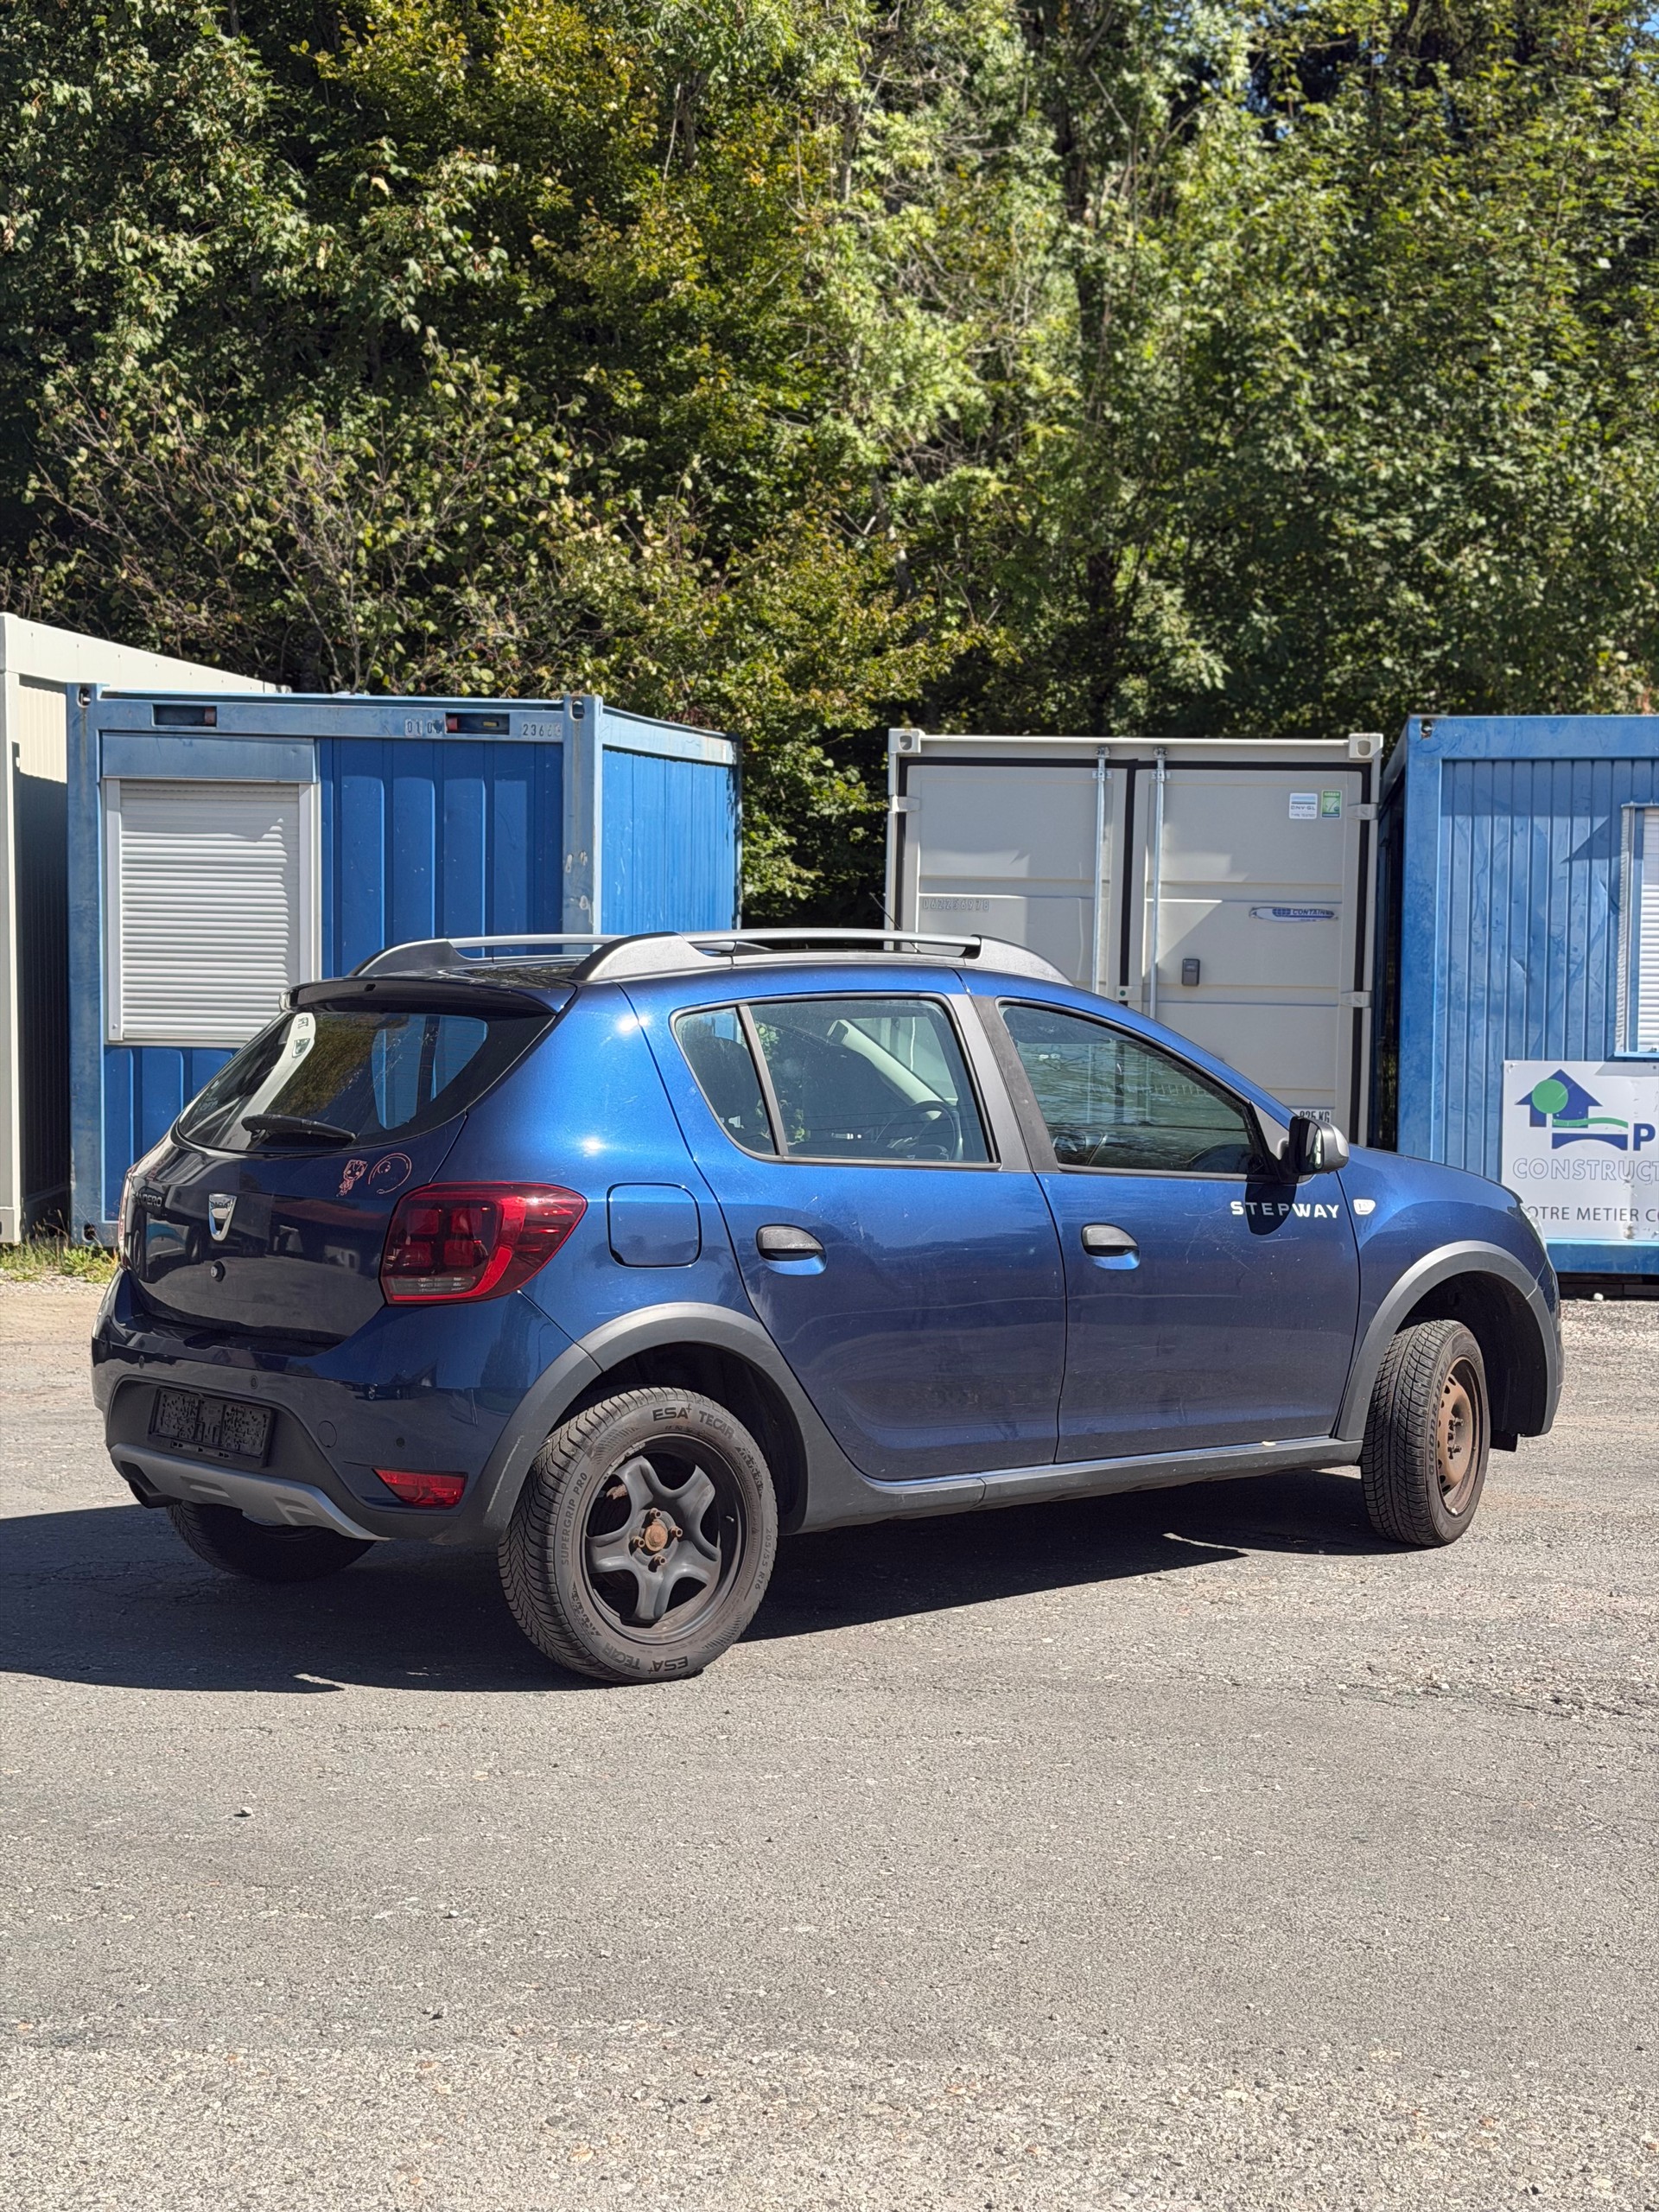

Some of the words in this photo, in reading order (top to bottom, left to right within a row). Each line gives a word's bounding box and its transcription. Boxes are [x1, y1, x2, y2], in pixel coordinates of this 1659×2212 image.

[1319, 1111, 1330, 1123] KG
[1230, 1201, 1339, 1218] STEPWAY
[1527, 1206, 1570, 1220] OTRE
[1576, 1207, 1639, 1222] METIER
[1645, 1209, 1659, 1223] C
[699, 1410, 734, 1440] TECAR
[561, 1498, 575, 1566] SUPERGRIP
[573, 1472, 588, 1495] PRO
[761, 1528, 772, 1567] 205/55
[754, 1571, 766, 1590] R16
